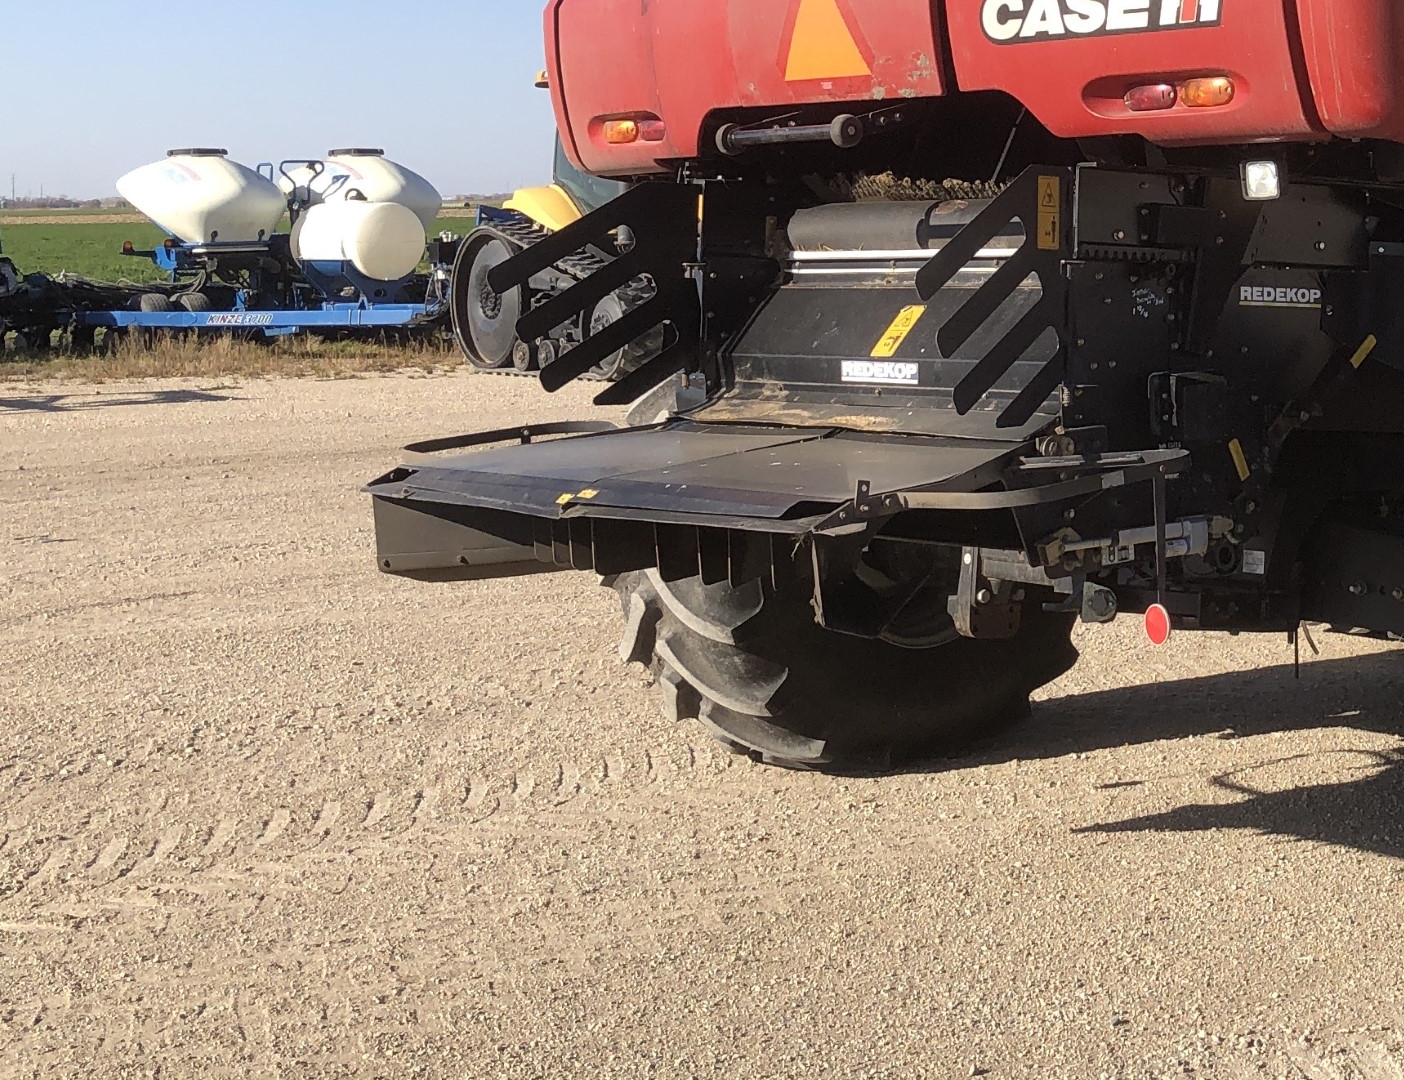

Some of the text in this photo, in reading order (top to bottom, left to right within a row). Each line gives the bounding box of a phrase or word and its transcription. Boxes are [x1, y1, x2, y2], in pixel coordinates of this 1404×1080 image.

[1240, 286, 1321, 303] REDEKOP
[206, 313, 274, 326] KINZE 3700
[841, 360, 918, 380] REDEKOP
